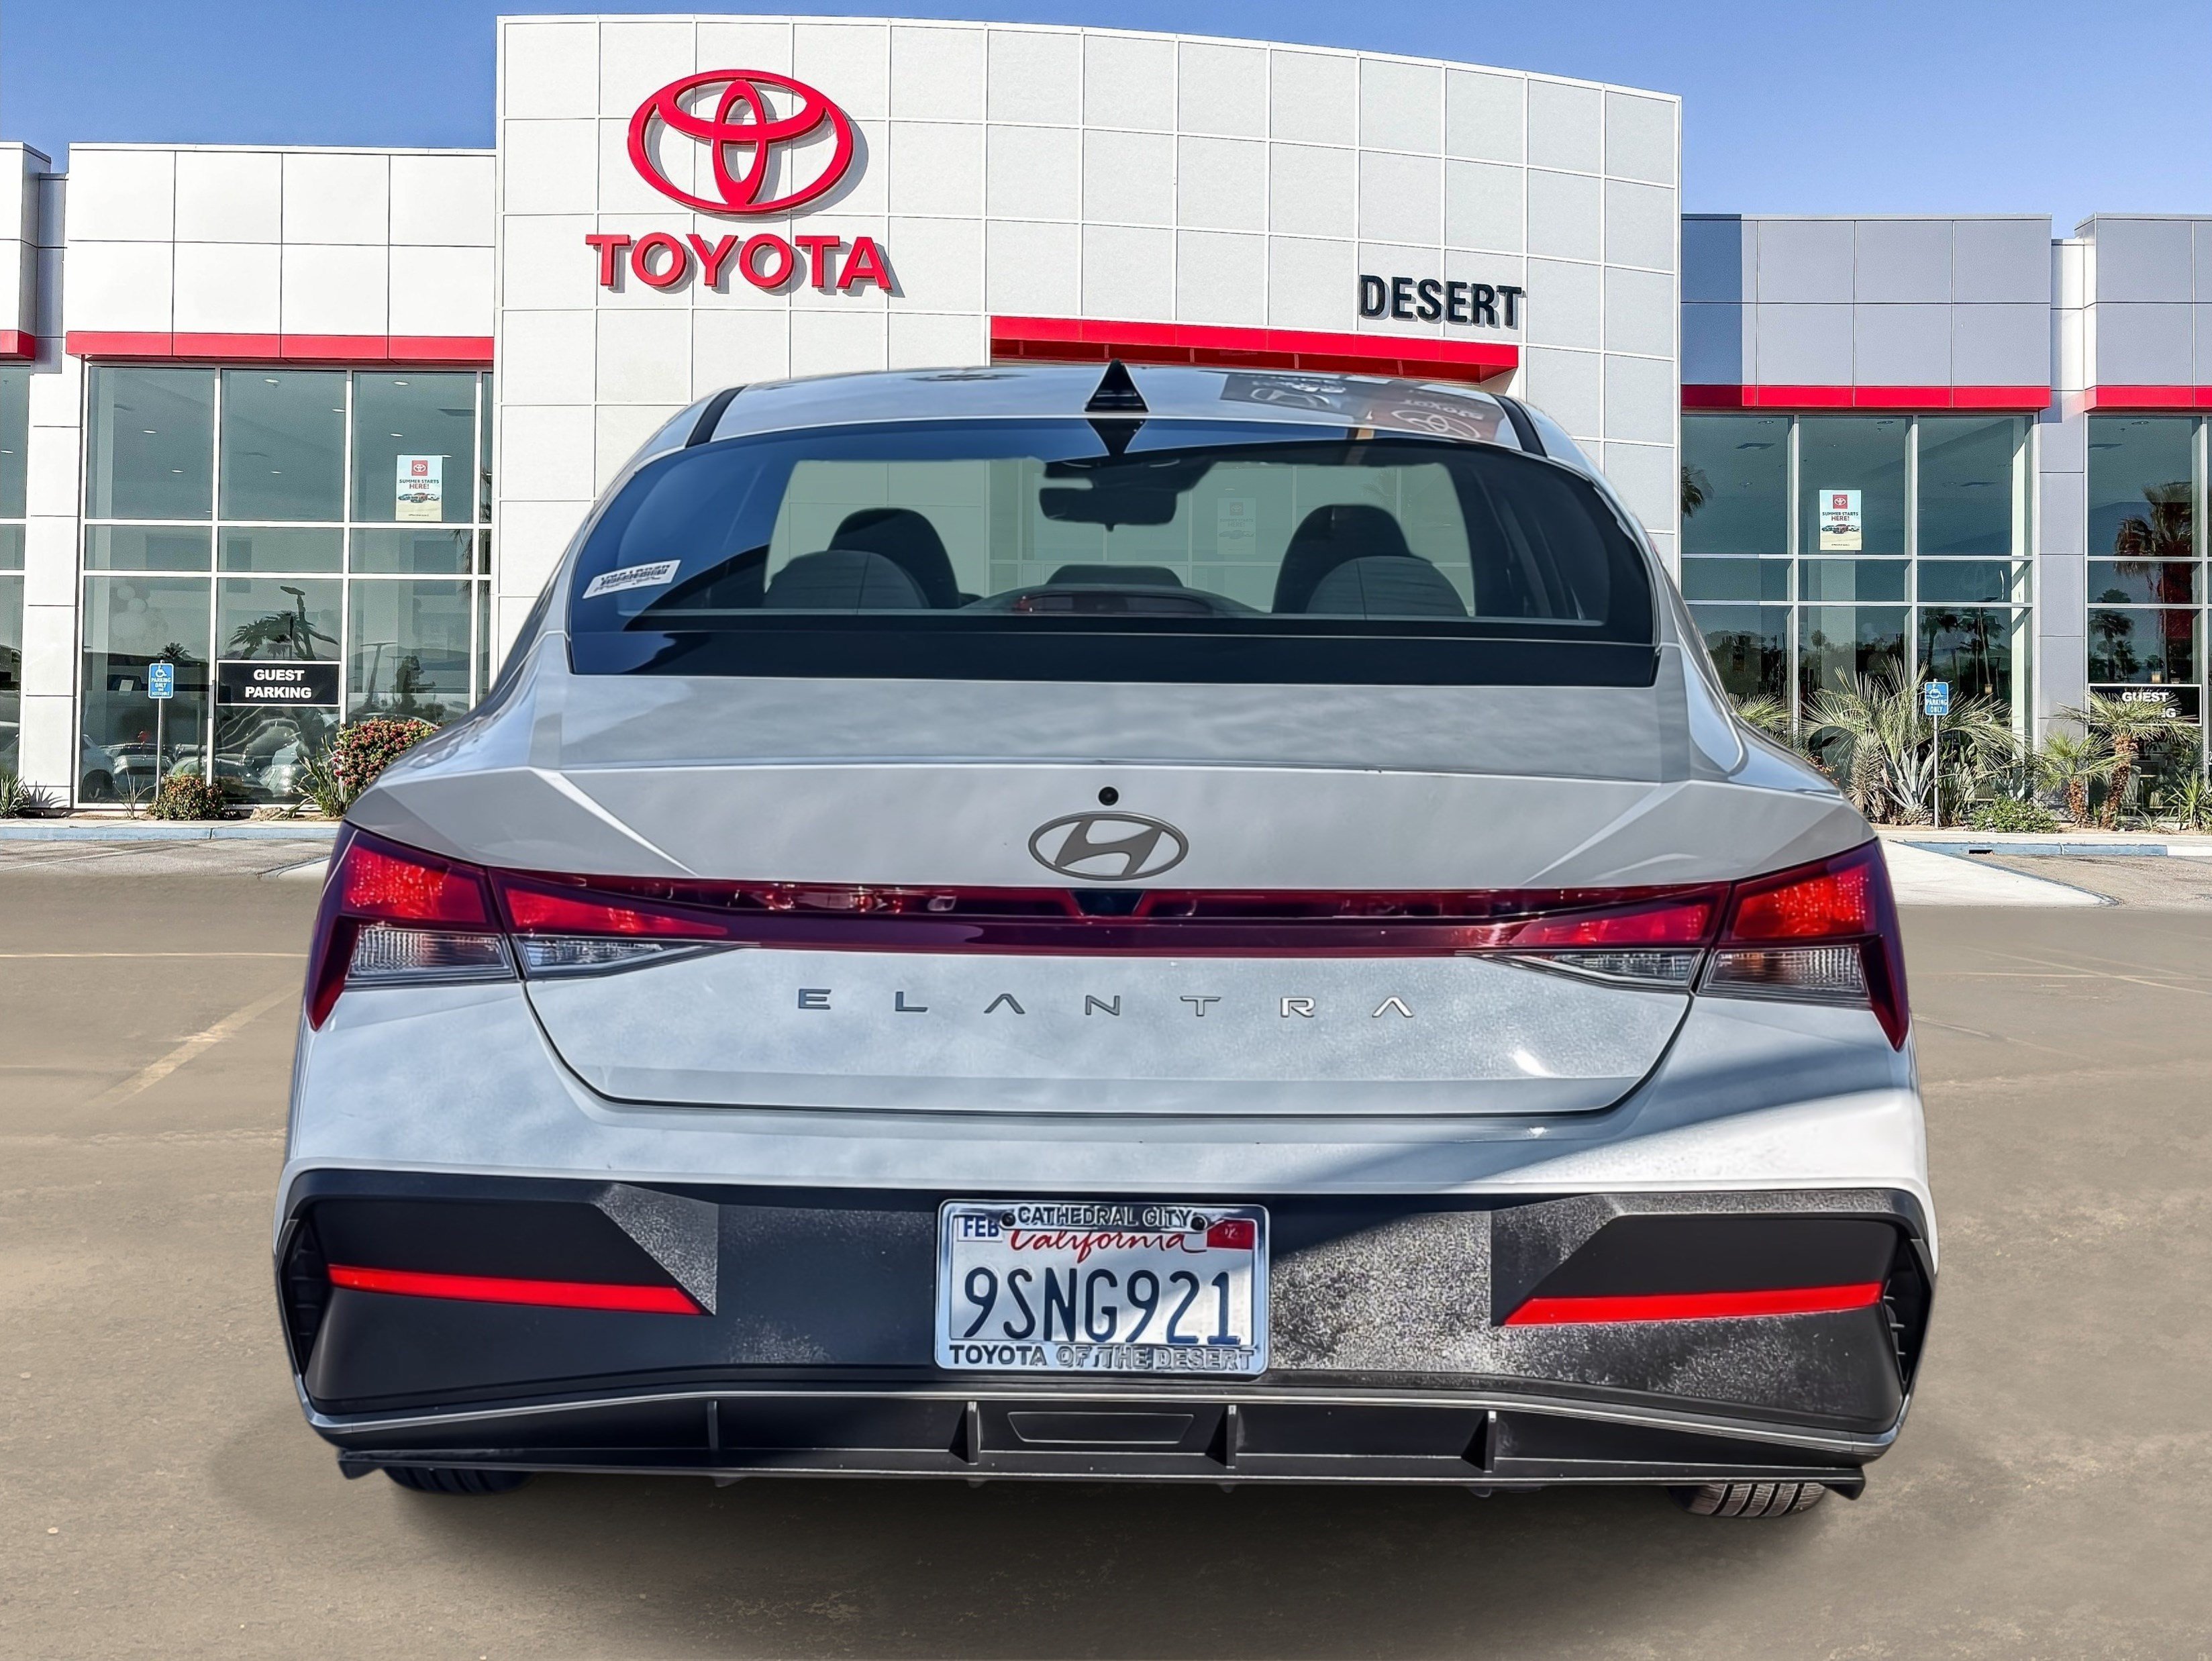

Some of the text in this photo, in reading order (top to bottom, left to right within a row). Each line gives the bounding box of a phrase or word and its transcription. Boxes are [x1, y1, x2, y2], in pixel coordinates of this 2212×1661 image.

[585, 232, 892, 290] TOYOTA
[1359, 274, 1521, 326] DESERT
[253, 668, 305, 681] GUEST
[245, 686, 312, 699] PARKING
[1926, 698, 1948, 706] PARKING
[1930, 705, 1944, 713] ONLY
[797, 988, 1415, 1019] ELANTRA
[963, 1215, 999, 1238] FEB
[1017, 1205, 1192, 1228] CATHEDRAL CITY
[1011, 1229, 1207, 1263] California
[963, 1266, 1242, 1344] 9SNG921
[949, 1344, 1255, 1370] TOYOTA OF THE DESERT
